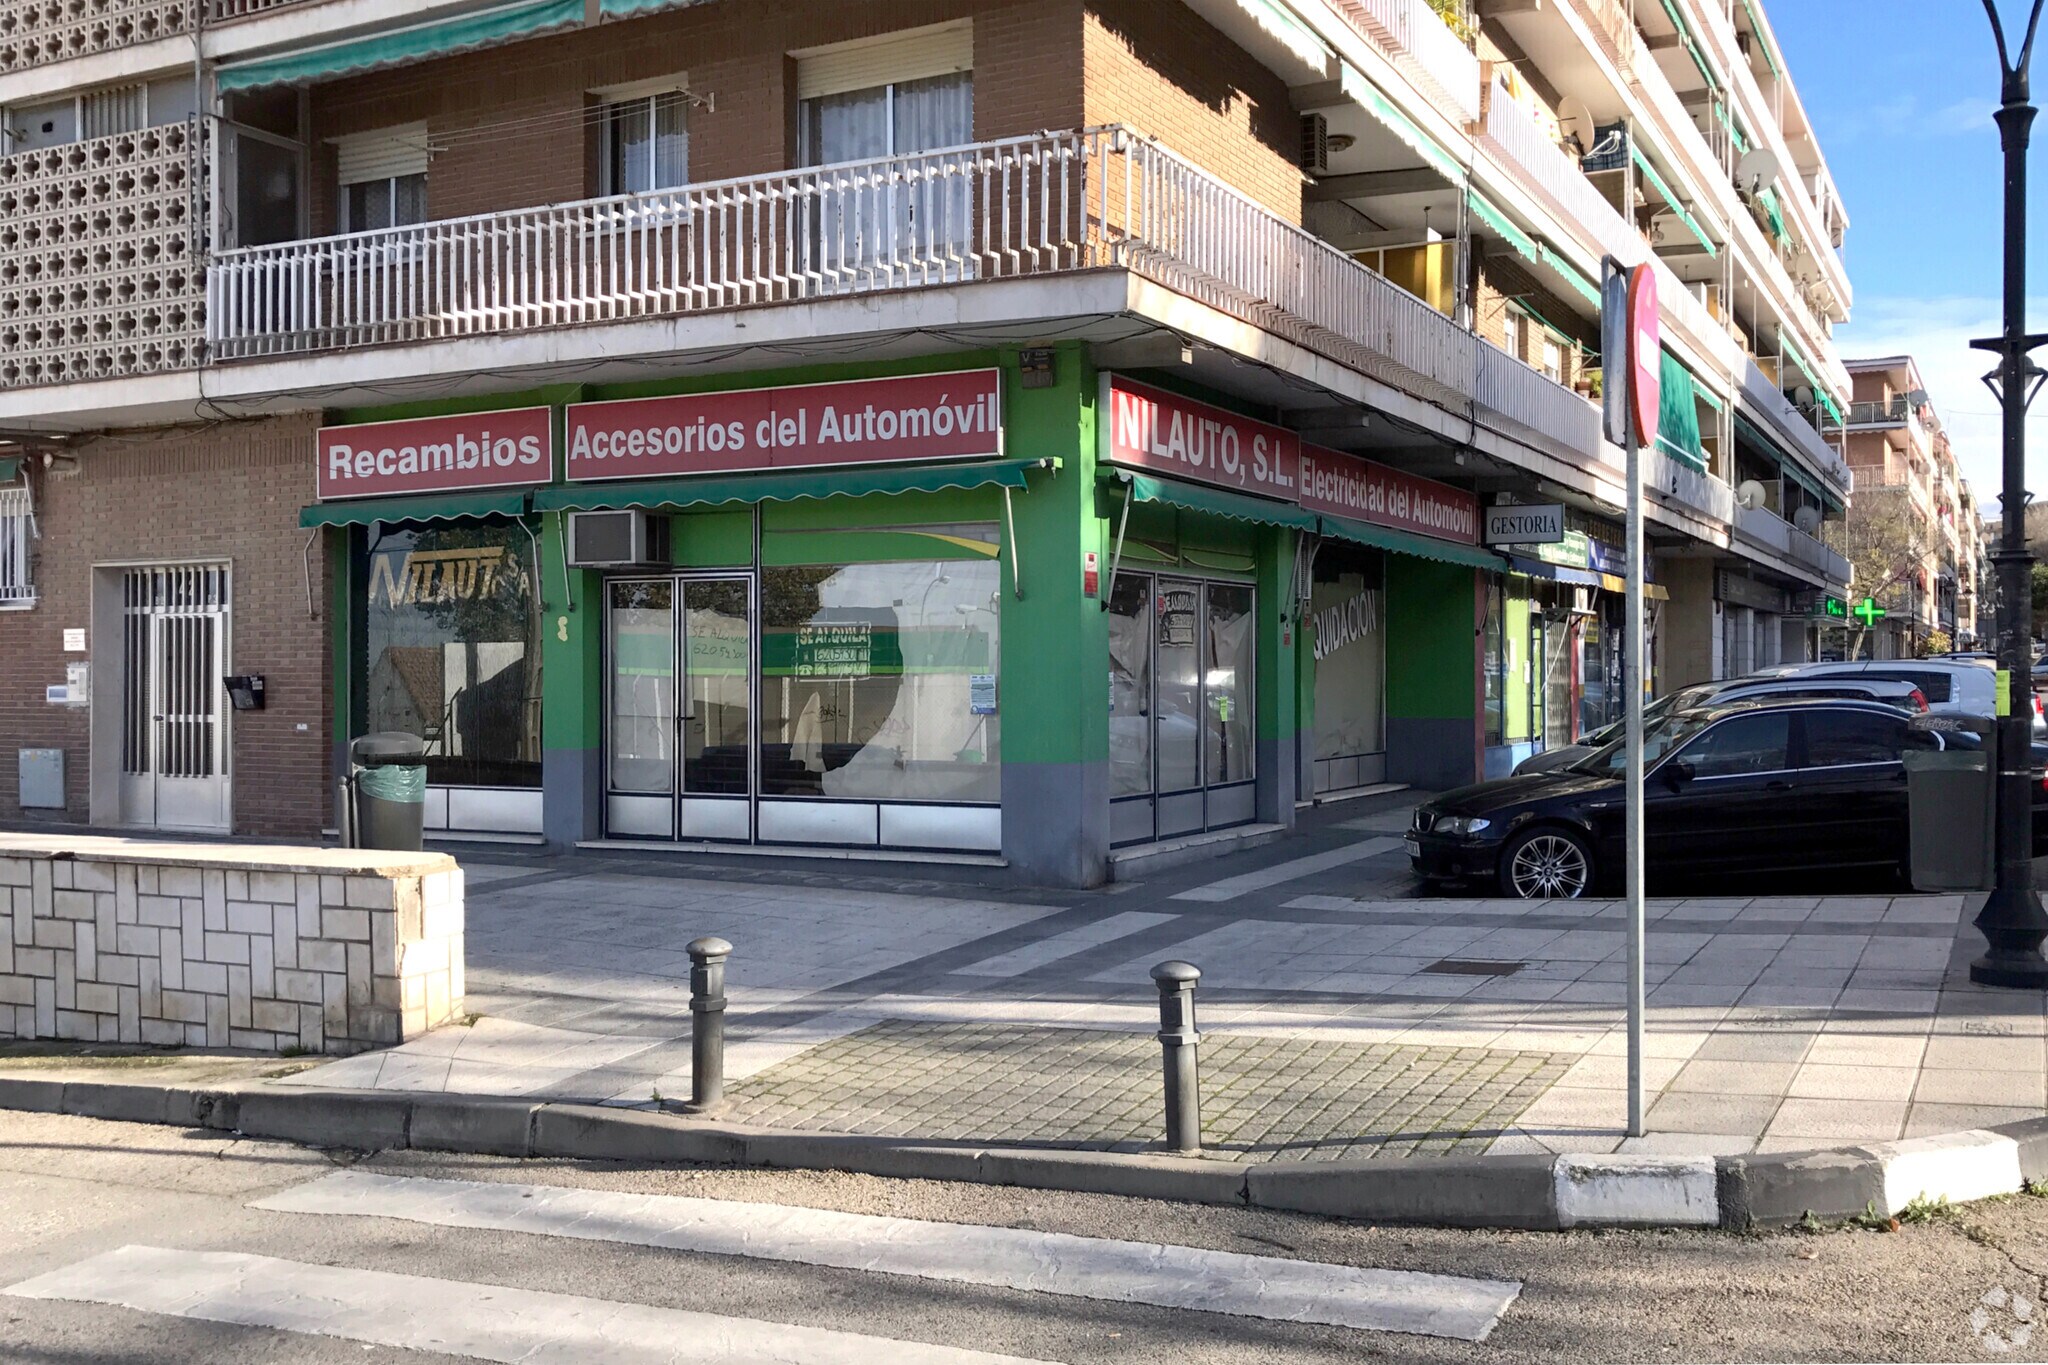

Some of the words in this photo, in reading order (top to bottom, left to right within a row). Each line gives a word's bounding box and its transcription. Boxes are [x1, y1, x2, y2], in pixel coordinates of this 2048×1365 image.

[328, 431, 541, 480] Recambios
[570, 416, 745, 461] Accesorios
[755, 408, 806, 449] del
[817, 393, 996, 444] Automóvil
[1118, 390, 1246, 485] NILAUTO,
[1252, 434, 1294, 487] S.L.
[1301, 455, 1385, 514] Electricidad
[1388, 482, 1410, 518] del
[1412, 494, 1473, 536] Automóvil
[1491, 515, 1557, 535] GESTORIA
[799, 626, 814, 646] SE
[815, 626, 867, 645] ALQUILA
